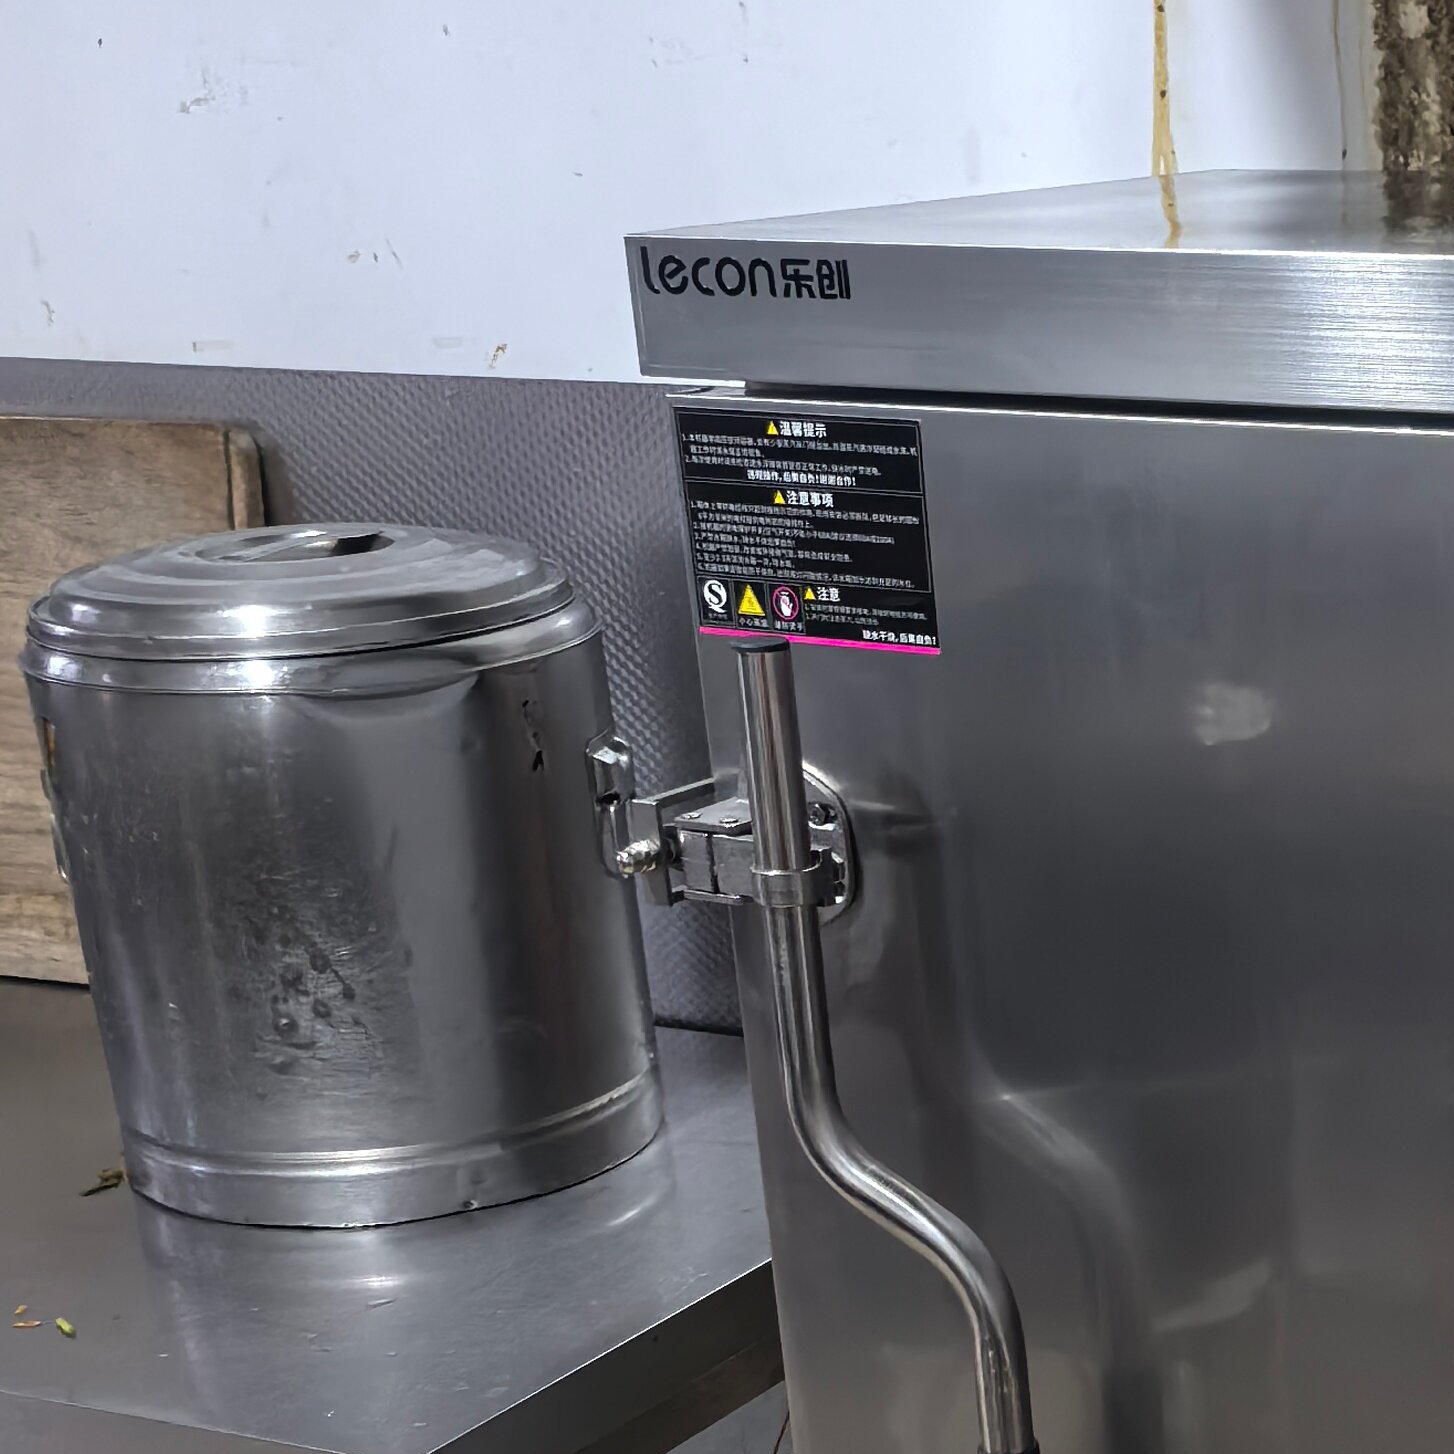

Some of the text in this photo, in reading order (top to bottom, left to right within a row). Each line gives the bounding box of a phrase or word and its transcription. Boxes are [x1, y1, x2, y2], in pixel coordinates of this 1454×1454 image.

[779, 420, 827, 439] 温馨提示
[786, 490, 834, 509] 注意事项
[816, 586, 841, 602] 注意
